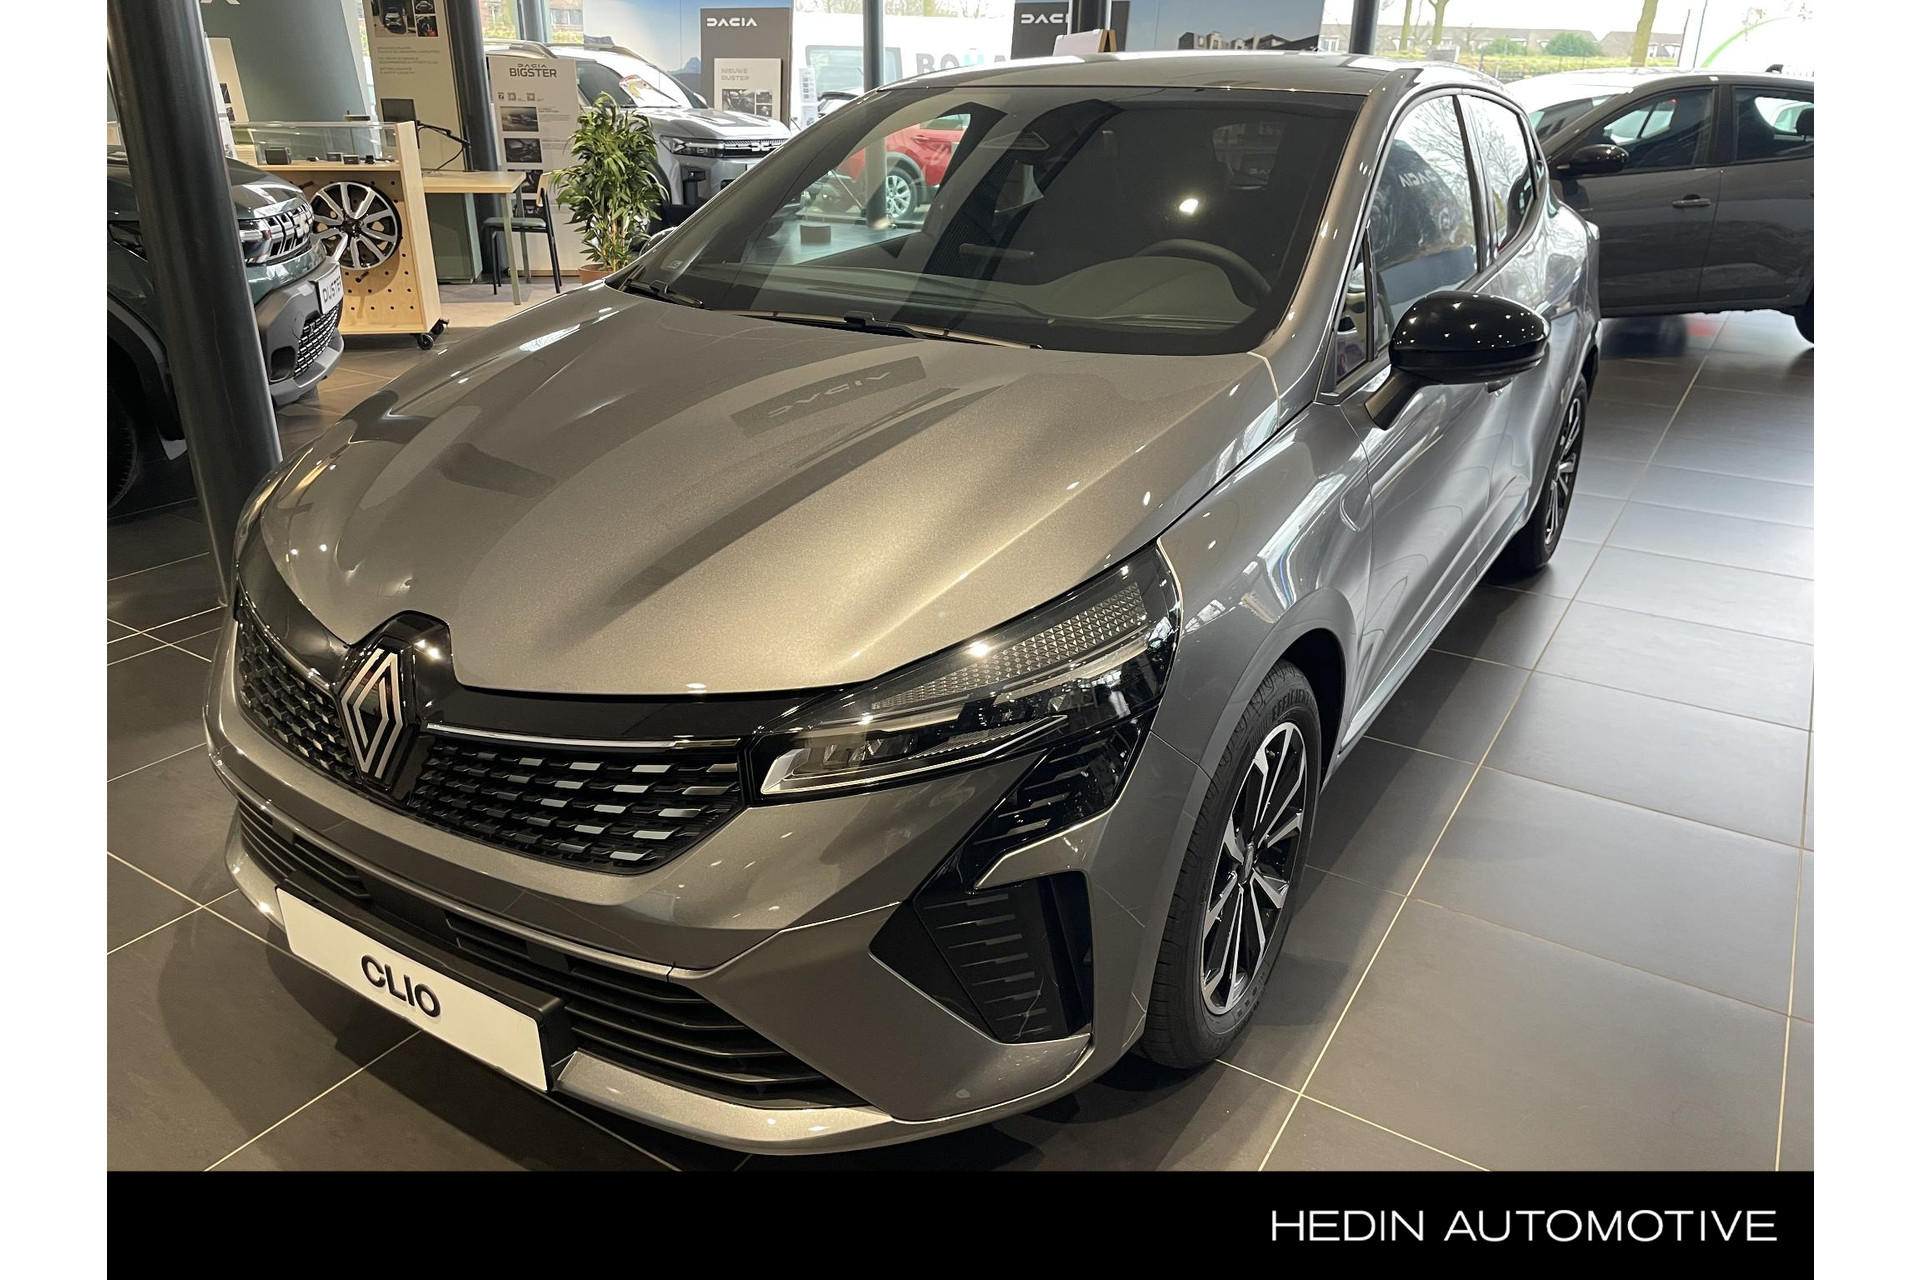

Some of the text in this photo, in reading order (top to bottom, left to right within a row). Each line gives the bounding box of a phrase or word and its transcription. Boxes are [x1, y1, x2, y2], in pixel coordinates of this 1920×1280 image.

[707, 17, 758, 27] DACIA
[1020, 13, 1069, 24] DACI
[509, 67, 557, 78] BIGSTER
[361, 954, 441, 1018] CLIO
